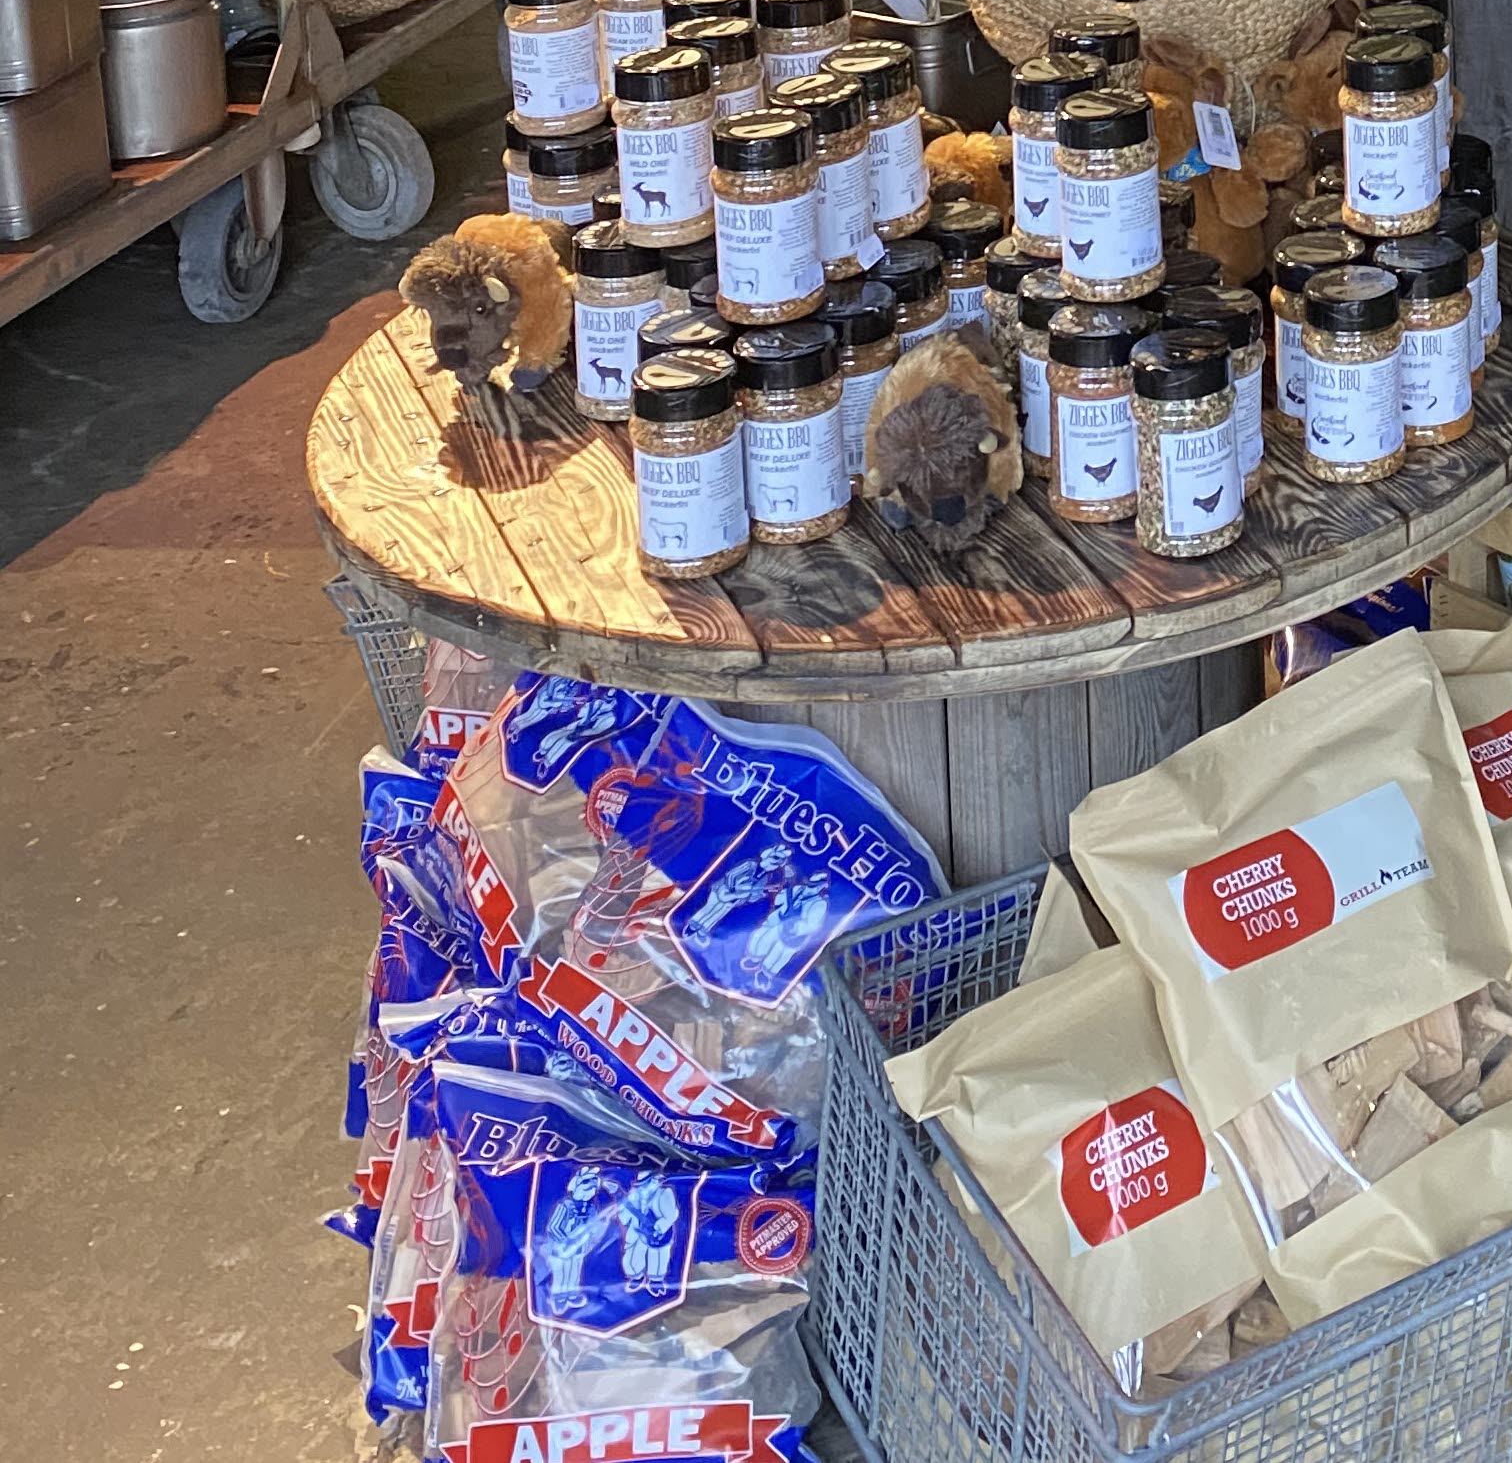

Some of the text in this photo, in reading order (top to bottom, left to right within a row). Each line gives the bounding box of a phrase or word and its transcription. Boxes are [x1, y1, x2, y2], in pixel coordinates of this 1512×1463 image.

[656, 132, 678, 155] BBQ
[1388, 125, 1409, 147] BBQ
[1087, 185, 1111, 208] BBQ
[750, 208, 773, 232] BBQ
[614, 309, 636, 333] BBQ
[1421, 333, 1442, 357] BBQ
[1339, 369, 1361, 392] BBQ
[1069, 404, 1107, 427] ZIGGES
[787, 424, 811, 449] BBQ
[1174, 433, 1215, 461] ZIGGES
[677, 460, 701, 485] BBQ
[1213, 853, 1286, 898] CHERRY
[1340, 858, 1429, 907] GRILL TEAM
[1221, 877, 1297, 922] CHUNKS
[1240, 907, 1299, 941] 1000 g
[558, 1020, 617, 1087] WOOD
[579, 991, 735, 1116] APPLE
[619, 1085, 716, 1148] CHUNKS
[1085, 1110, 1157, 1164] CHERRY
[1090, 1136, 1170, 1192] CHUNKS
[1109, 1171, 1169, 1214] 1000 g
[511, 1408, 705, 1463] APPLE
